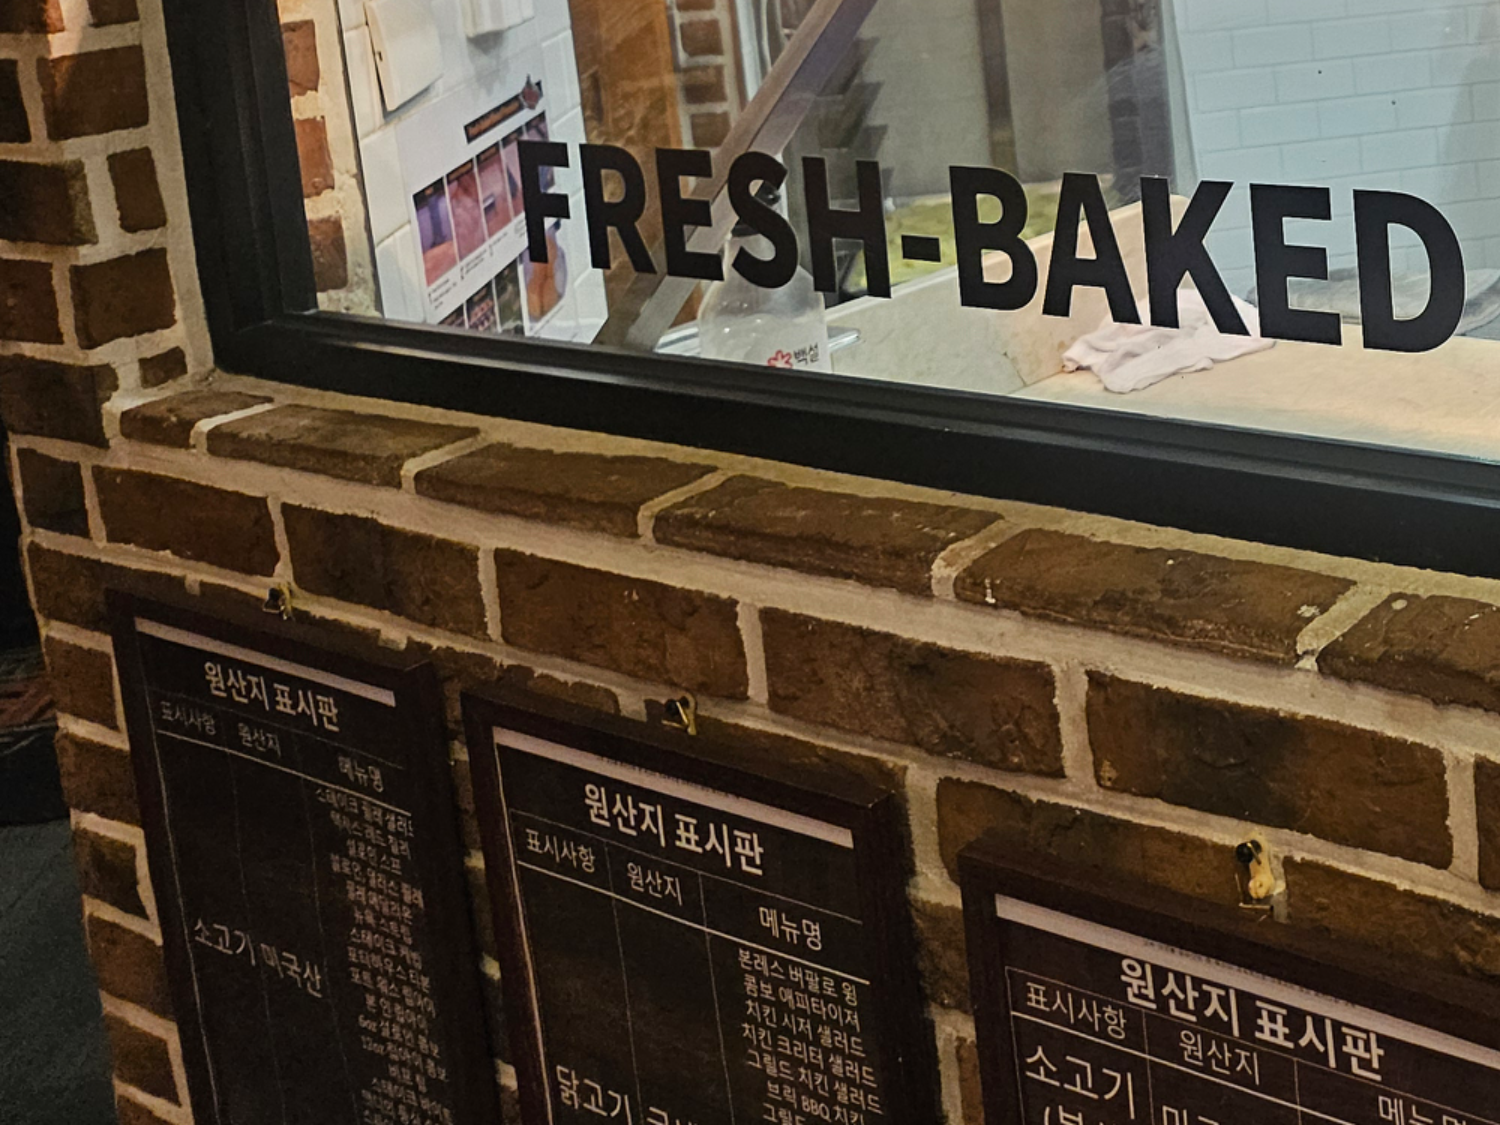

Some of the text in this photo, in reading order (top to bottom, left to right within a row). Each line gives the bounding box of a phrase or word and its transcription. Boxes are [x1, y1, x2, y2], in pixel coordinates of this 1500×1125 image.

[517, 139, 1466, 353] FRESH-BAKED
[203, 661, 341, 732] 원산지 표시판
[159, 700, 384, 793] 표시사항 원산지 메뉴명
[583, 782, 764, 876] 원산지 표시판
[524, 828, 823, 952] 표시사항 원산지 메뉴명
[193, 917, 323, 998] 소고기 미국산
[737, 948, 858, 1007] 본레스 버팔로 윙
[743, 972, 777, 1001] 콤보
[741, 1022, 879, 1089] 치킨 크리터 샐러드
[744, 998, 867, 1058] 치킨 시저 샐러드
[1025, 981, 1128, 1041] 표시사항
[1178, 1028, 1261, 1086] 원산지
[1119, 956, 1241, 1038] 원산지
[1254, 999, 1386, 1082] 표시판
[555, 1064, 634, 1125] 닭고기
[746, 1049, 885, 1115] 그릴드 치킨 샐러드
[800, 1095, 832, 1123] BBQ
[1024, 1044, 1136, 1121] 소고기
